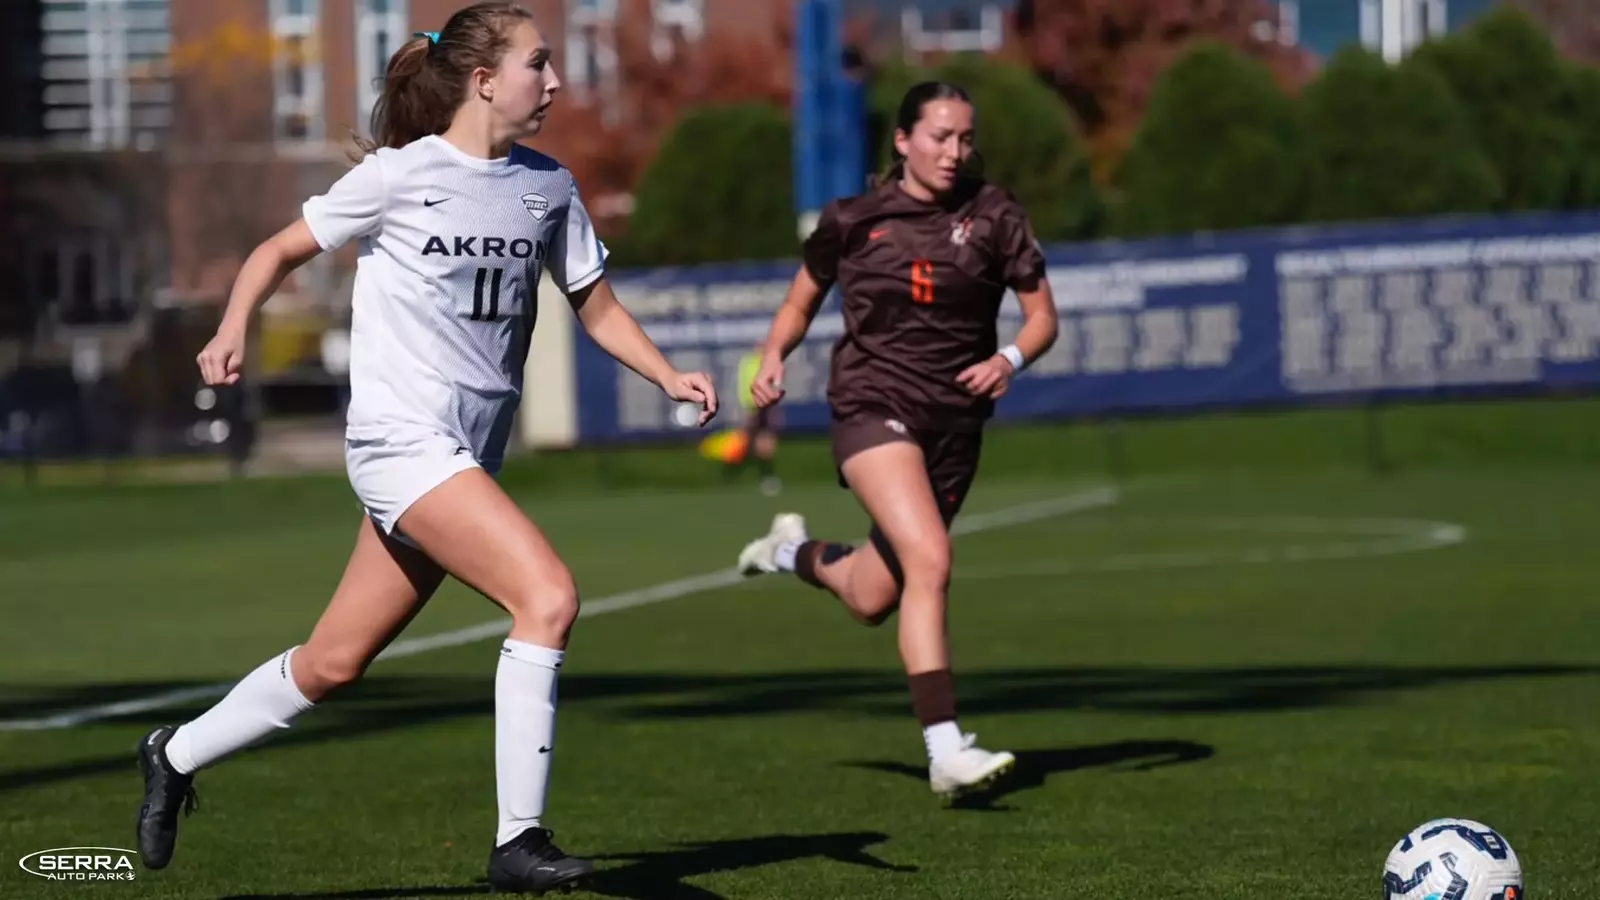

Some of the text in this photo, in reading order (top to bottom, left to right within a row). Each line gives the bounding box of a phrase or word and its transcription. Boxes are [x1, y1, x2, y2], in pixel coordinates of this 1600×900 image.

[421, 236, 547, 260] AKRON
[470, 267, 503, 321] 11
[911, 258, 934, 304] 6
